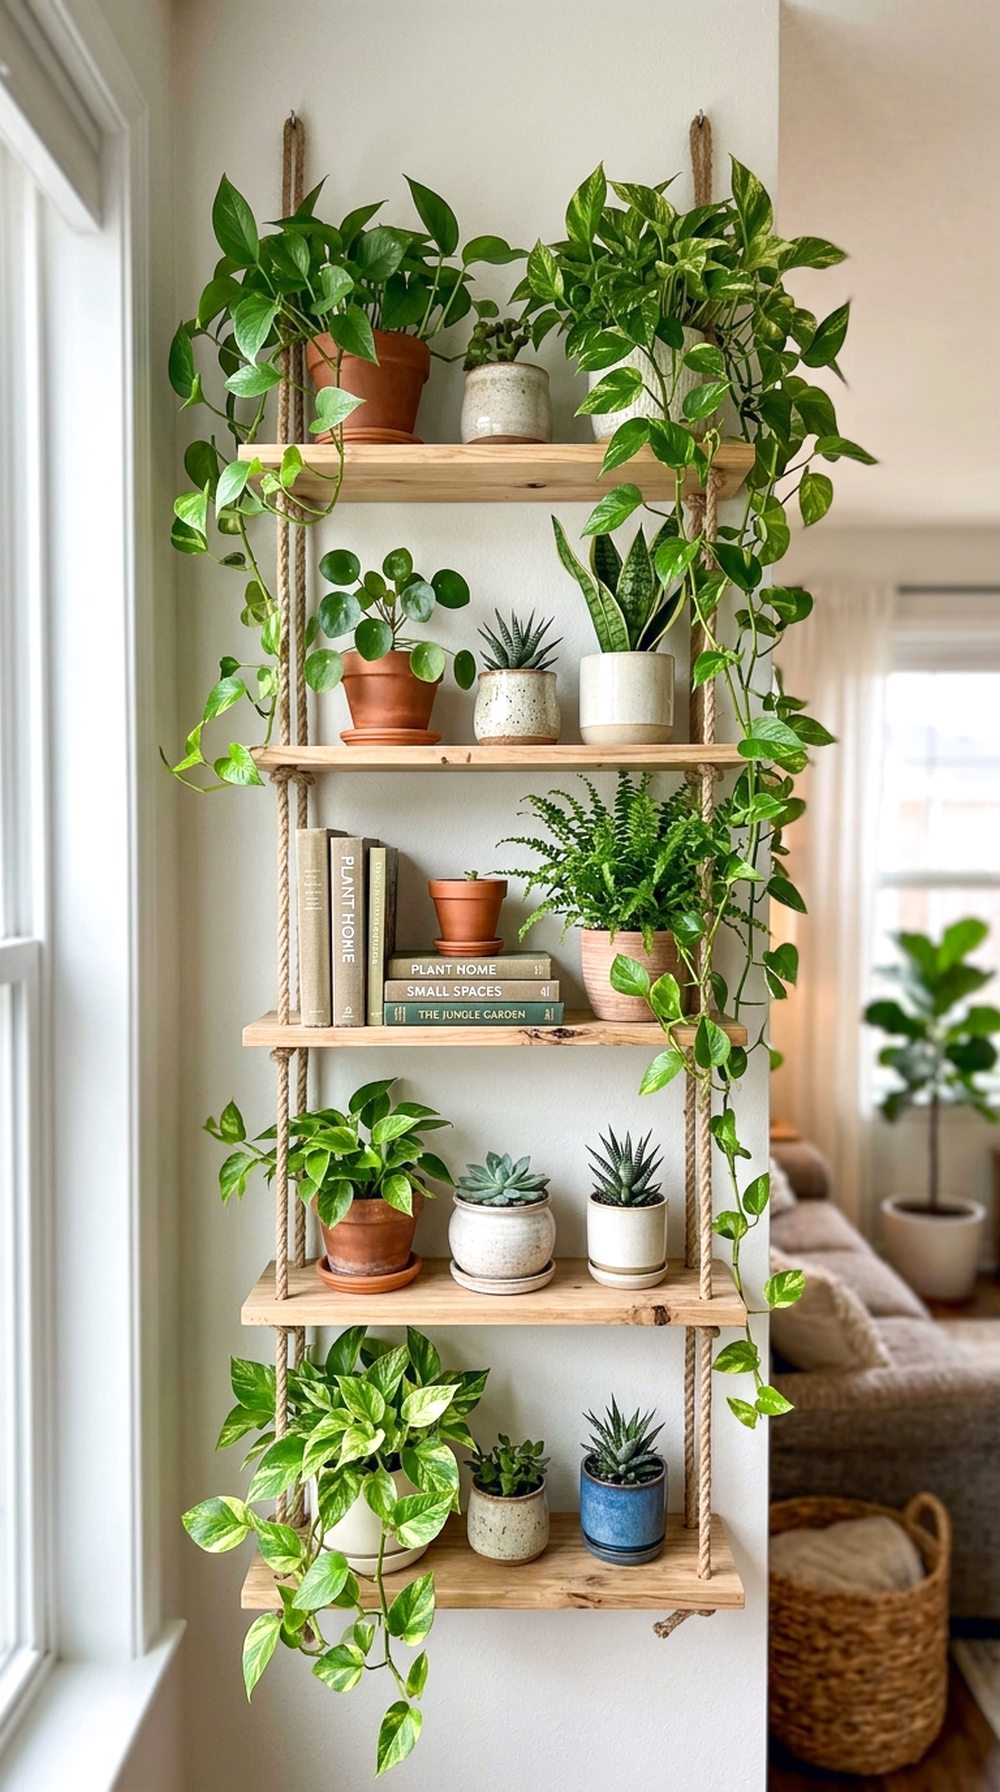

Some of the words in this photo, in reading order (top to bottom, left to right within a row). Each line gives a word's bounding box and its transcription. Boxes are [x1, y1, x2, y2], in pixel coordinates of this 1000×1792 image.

[341, 856, 355, 909] PLANT
[341, 913, 355, 963] HOME
[411, 964, 453, 975] PLANT
[456, 964, 497, 975] HOME
[406, 986, 450, 997] SMALL
[453, 986, 502, 997] SPACES
[418, 1010, 439, 1019] THE
[442, 1010, 480, 1020] JUNGLE
[483, 1009, 526, 1019] GARDEN
